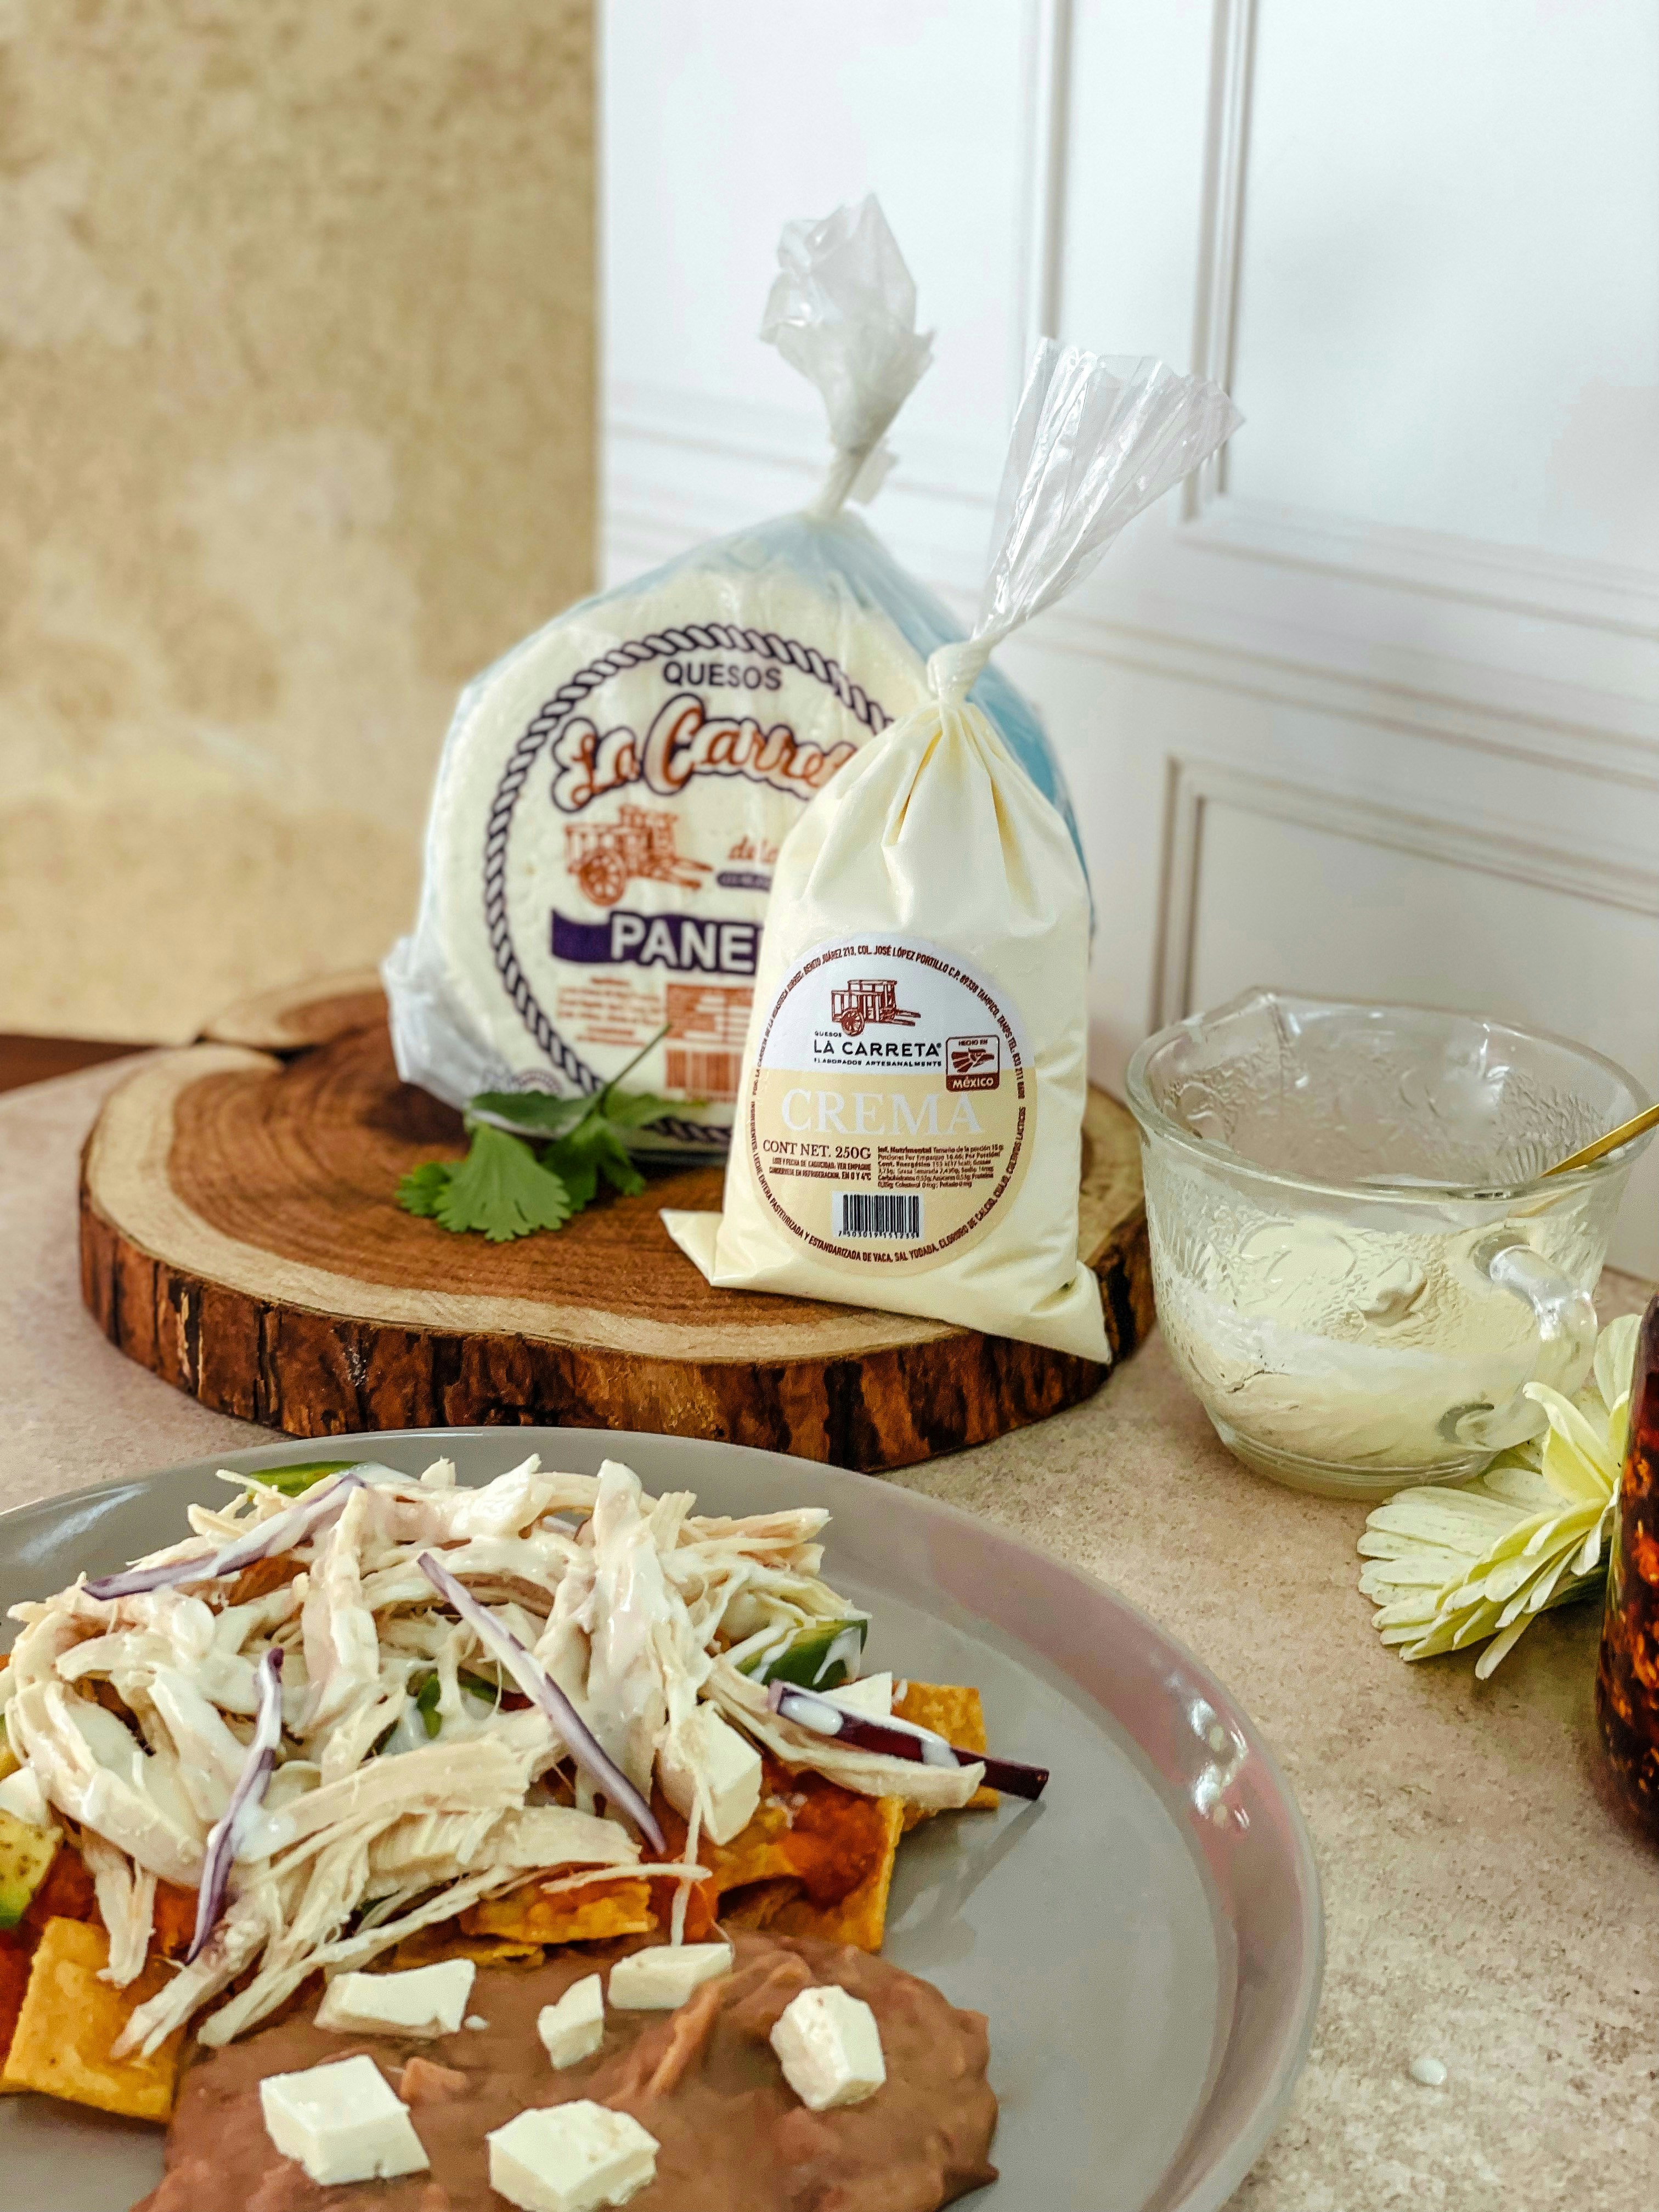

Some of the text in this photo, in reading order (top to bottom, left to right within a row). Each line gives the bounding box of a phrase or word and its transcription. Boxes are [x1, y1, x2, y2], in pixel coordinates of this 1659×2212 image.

[664, 662, 782, 691] QUESOS
[558, 700, 858, 810] La Carre
[611, 916, 755, 972] PANE
[873, 944, 892, 956] JOSÉ
[892, 946, 916, 961] LÓPEZ
[916, 952, 949, 973] PORTILLO
[948, 967, 961, 980] C.P.
[814, 1039, 940, 1057] LA CARRETA
[952, 1076, 994, 1088] MÉXICO
[781, 1088, 983, 1136] CREMA
[763, 1139, 872, 1160] CONT NET. 250G
[842, 1171, 850, 1180] EN
[753, 1152, 763, 1176] LECHE
[758, 1173, 772, 1201] ENTERA
[769, 1197, 804, 1239] PASTEURIZADA
[804, 1231, 810, 1241] Y
[808, 1235, 861, 1261] ESTANDARIZADA
[862, 1251, 872, 1262] DE
